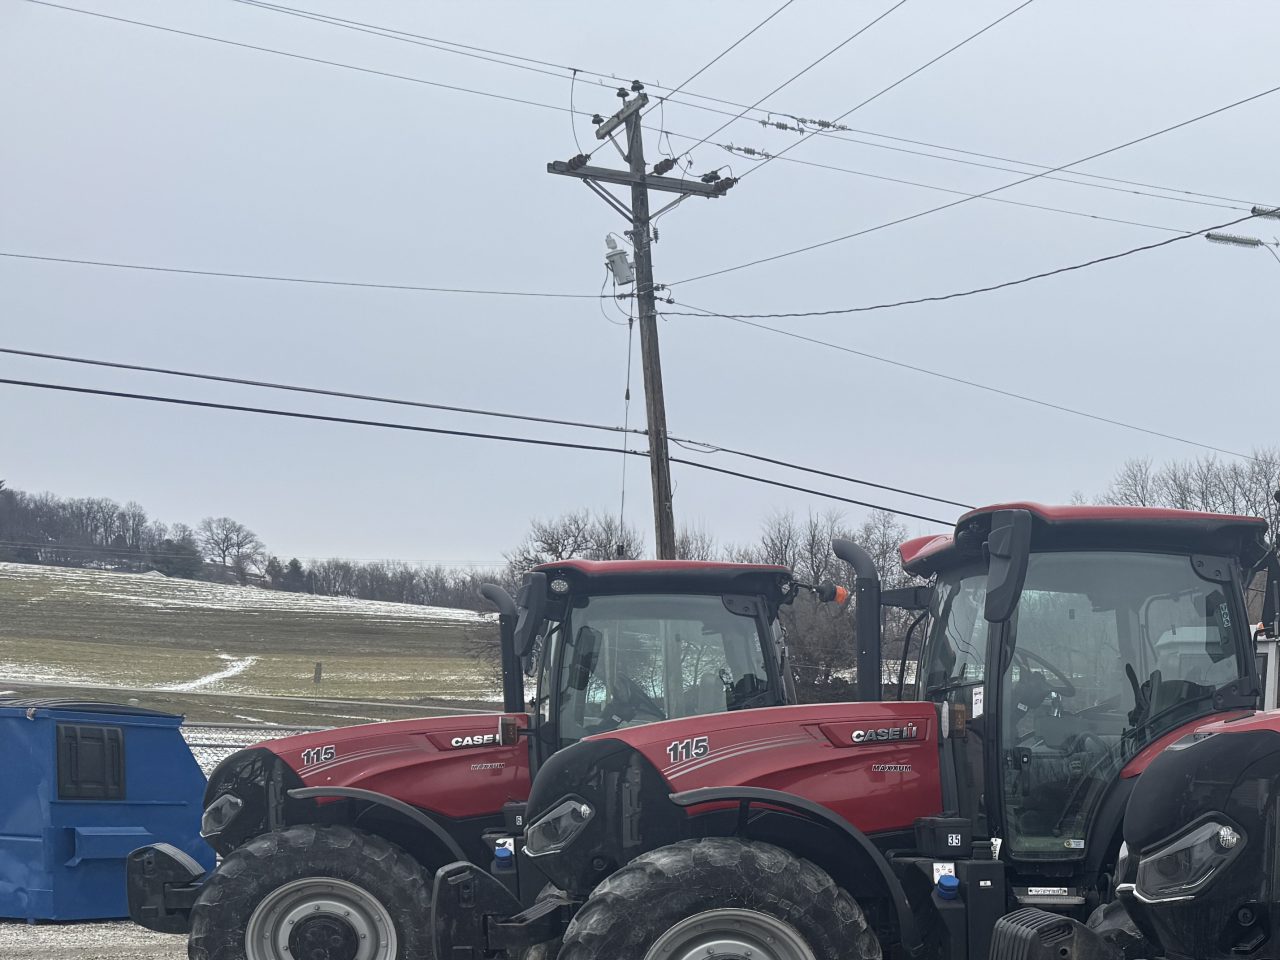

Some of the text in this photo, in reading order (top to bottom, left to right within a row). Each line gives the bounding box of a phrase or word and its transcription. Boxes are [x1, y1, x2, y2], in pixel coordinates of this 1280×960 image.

[451, 734, 494, 747] CASE
[851, 727, 900, 742] CASE
[301, 744, 336, 766] 115
[666, 736, 709, 763] 115
[871, 764, 912, 772] MAXXUM
[948, 834, 961, 846] 35
